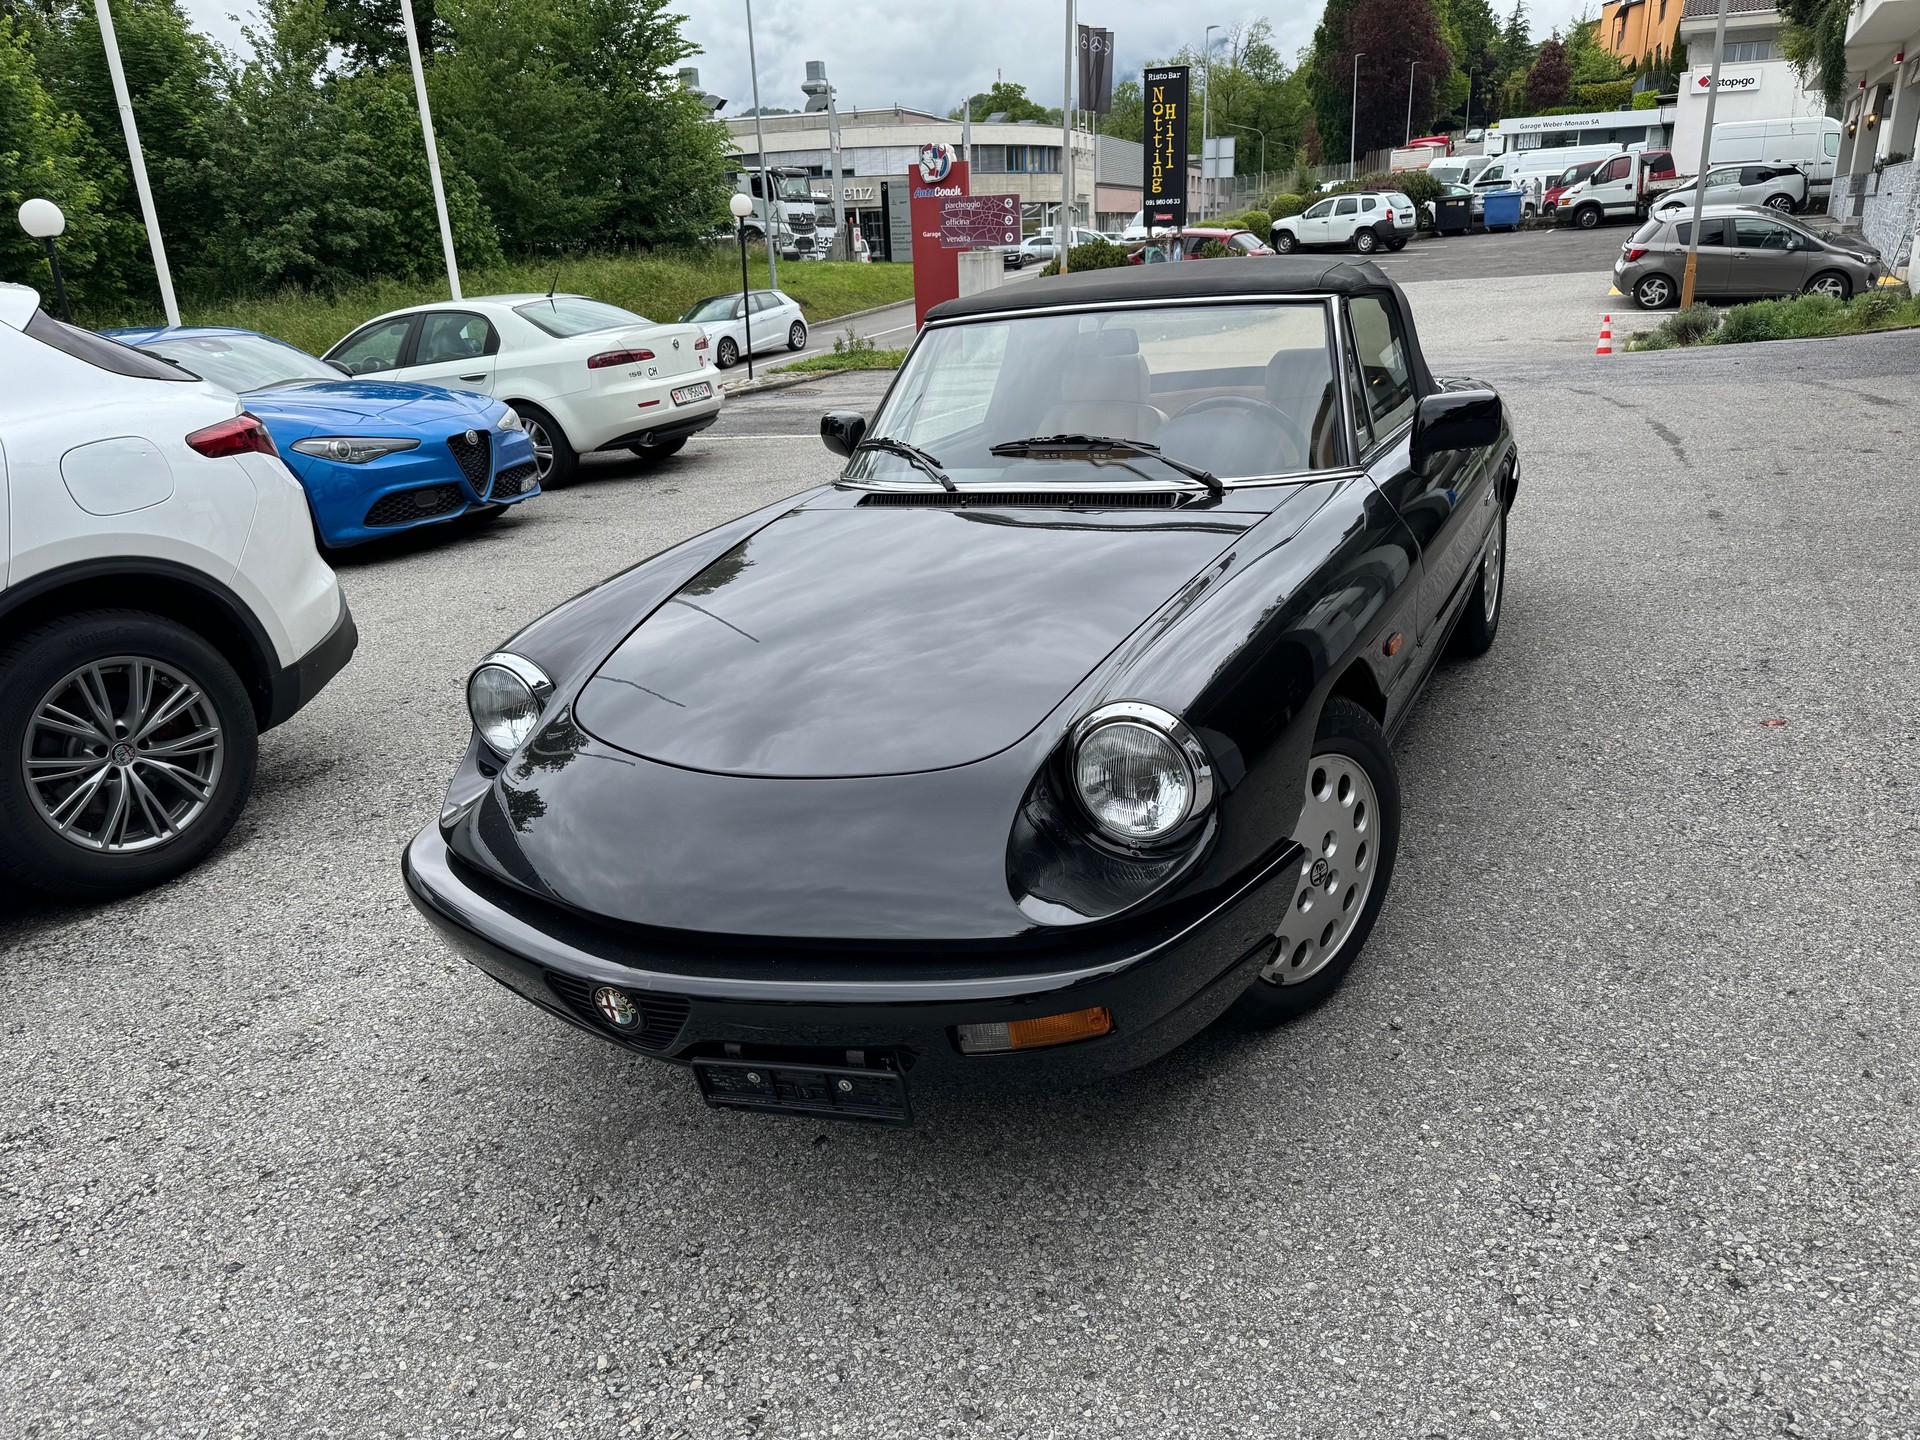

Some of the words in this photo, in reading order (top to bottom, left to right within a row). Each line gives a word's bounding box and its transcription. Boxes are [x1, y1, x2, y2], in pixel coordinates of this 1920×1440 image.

[1148, 73, 1167, 81] Risto
[1168, 71, 1181, 79] Bar
[1519, 122, 1541, 130] Garage
[1542, 120, 1590, 128] Weber-Monaco
[1152, 86, 1164, 193] Notting
[1165, 103, 1177, 169] Hill
[945, 200, 981, 210] parcheggio
[945, 218, 970, 226] officina
[946, 235, 971, 243] vendita
[628, 370, 642, 378] 159
[648, 366, 658, 376] CH
